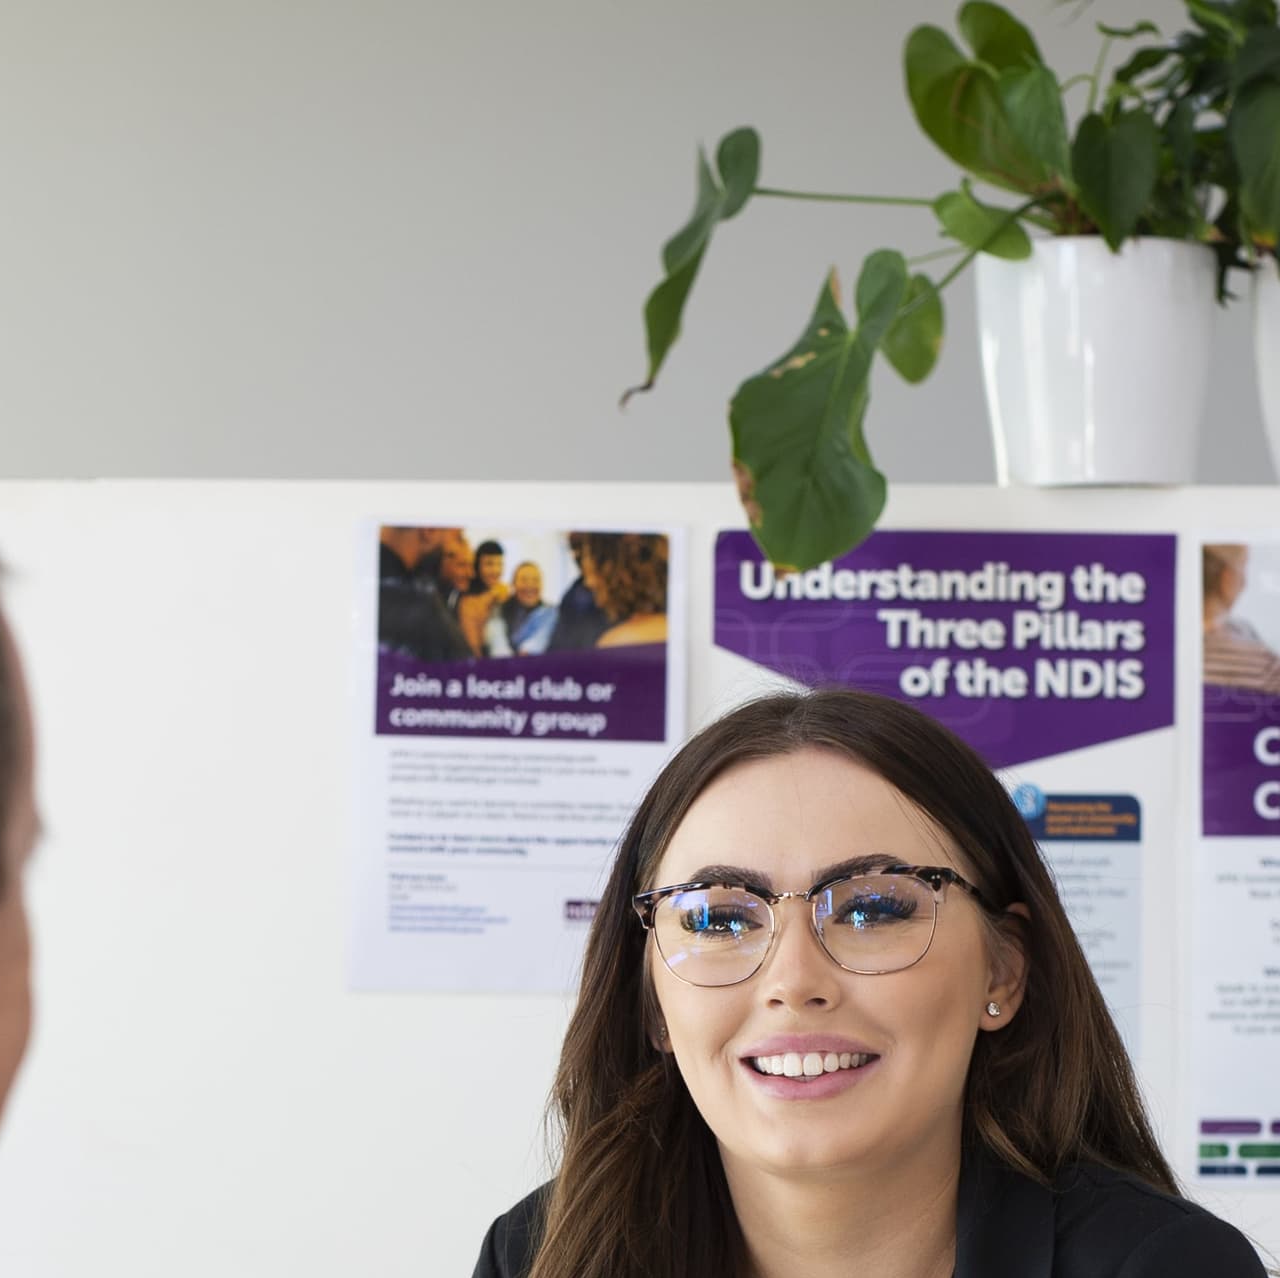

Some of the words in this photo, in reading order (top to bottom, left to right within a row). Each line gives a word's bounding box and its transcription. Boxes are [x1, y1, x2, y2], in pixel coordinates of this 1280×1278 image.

[740, 559, 1064, 609] Understanding
[1071, 564, 1145, 603] the
[877, 609, 1005, 649] Three
[1014, 611, 1145, 651] Pillars
[390, 673, 442, 698] Join
[446, 680, 462, 698] a
[467, 674, 524, 699] local
[529, 676, 582, 701] club
[586, 683, 615, 701] or
[900, 658, 950, 697] of
[954, 660, 1028, 697] the
[1035, 660, 1145, 699] NDIS
[389, 705, 527, 735] community
[532, 711, 607, 737] group
